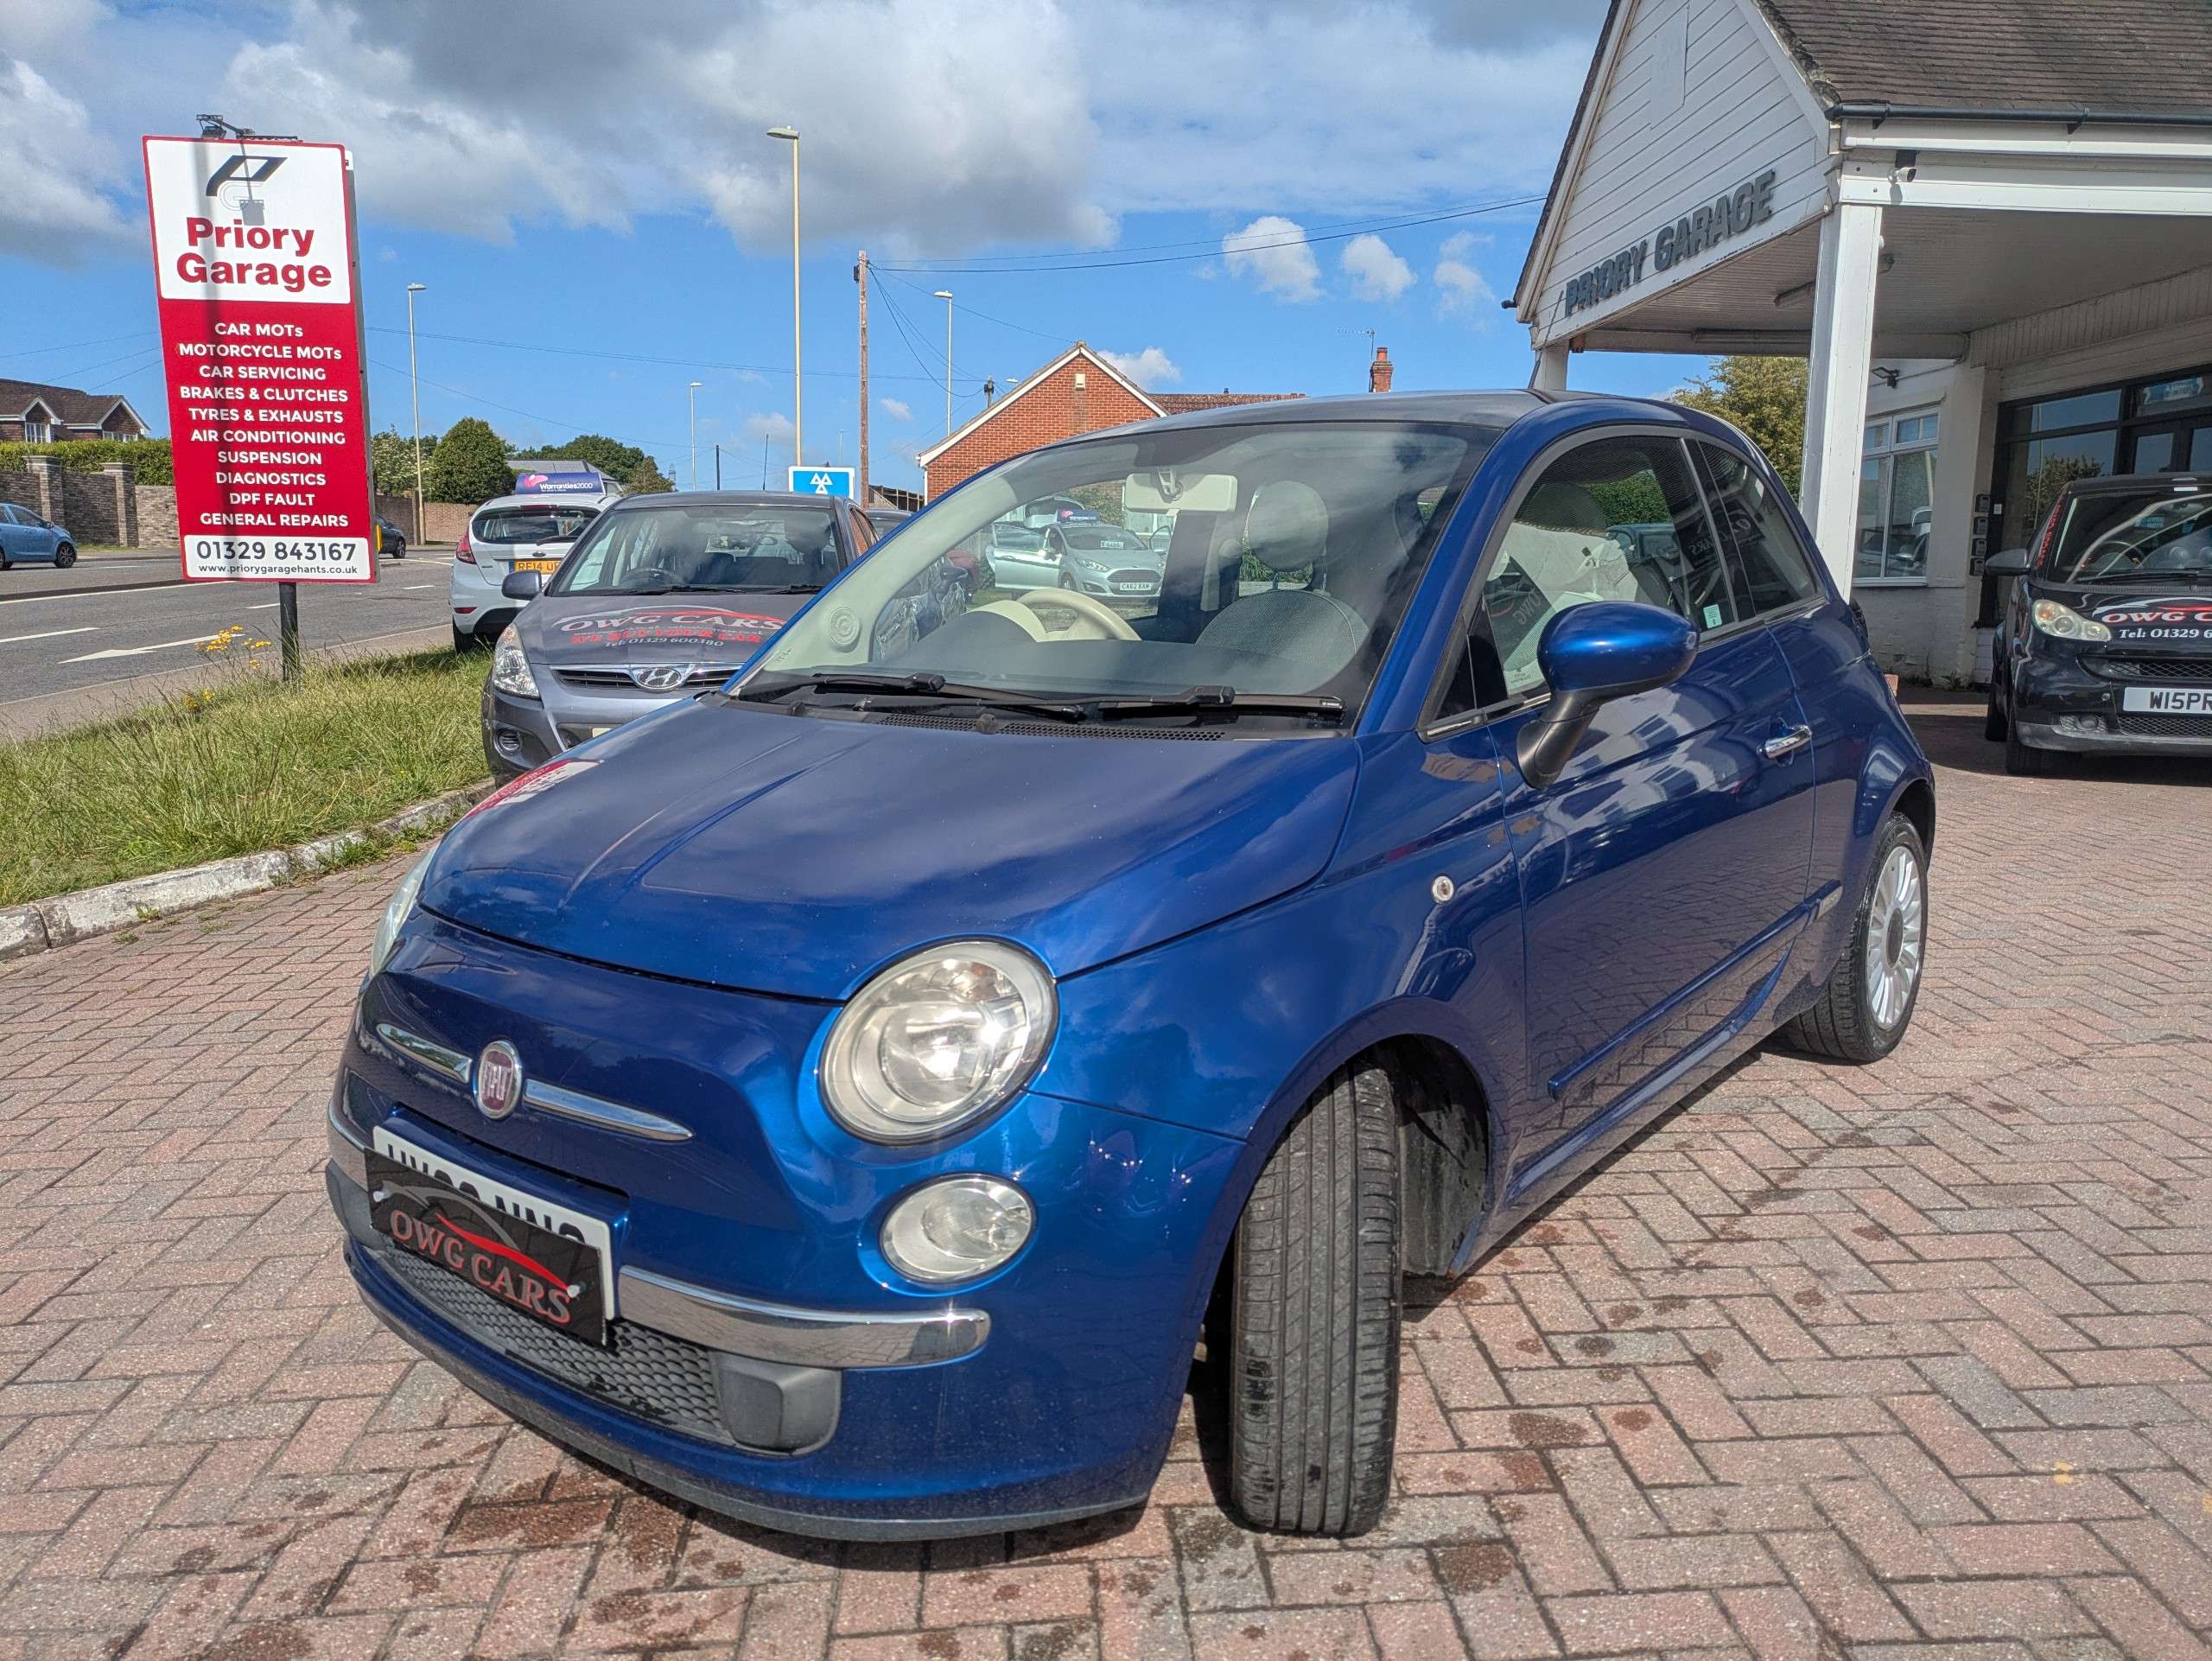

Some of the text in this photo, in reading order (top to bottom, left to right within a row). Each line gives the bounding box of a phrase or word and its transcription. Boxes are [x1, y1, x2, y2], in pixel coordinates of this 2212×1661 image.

[186, 217, 315, 257] Priory
[1564, 169, 1776, 318] PRIORY GARAGE
[176, 252, 333, 292] Garage
[214, 322, 303, 337] CAR MOTs
[179, 343, 342, 360] MOTORCYCLE MOTs
[199, 365, 327, 380] CAR SERVICING
[180, 385, 348, 402] BRAKES & CLUTCHES
[188, 408, 344, 423] TYRES & EXHAUSTS
[190, 430, 346, 444] AIR CONDITIONING
[218, 451, 322, 465] SUSPENSION
[216, 472, 327, 486] DIAGNOSTICS
[230, 493, 315, 506] DPF FAULT
[200, 512, 349, 527] GENERAL REPAIRS
[196, 540, 356, 561] 01329 843167
[199, 563, 358, 575] www.priorygaragehants.co.uk
[561, 615, 663, 631] OWG
[671, 614, 787, 630] CARS
[2101, 611, 2185, 623] OWG
[2120, 627, 2146, 639] Tel:
[2150, 628, 2200, 639] 01329
[670, 638, 724, 647] 600380
[390, 1210, 572, 1325] OWG CARS
